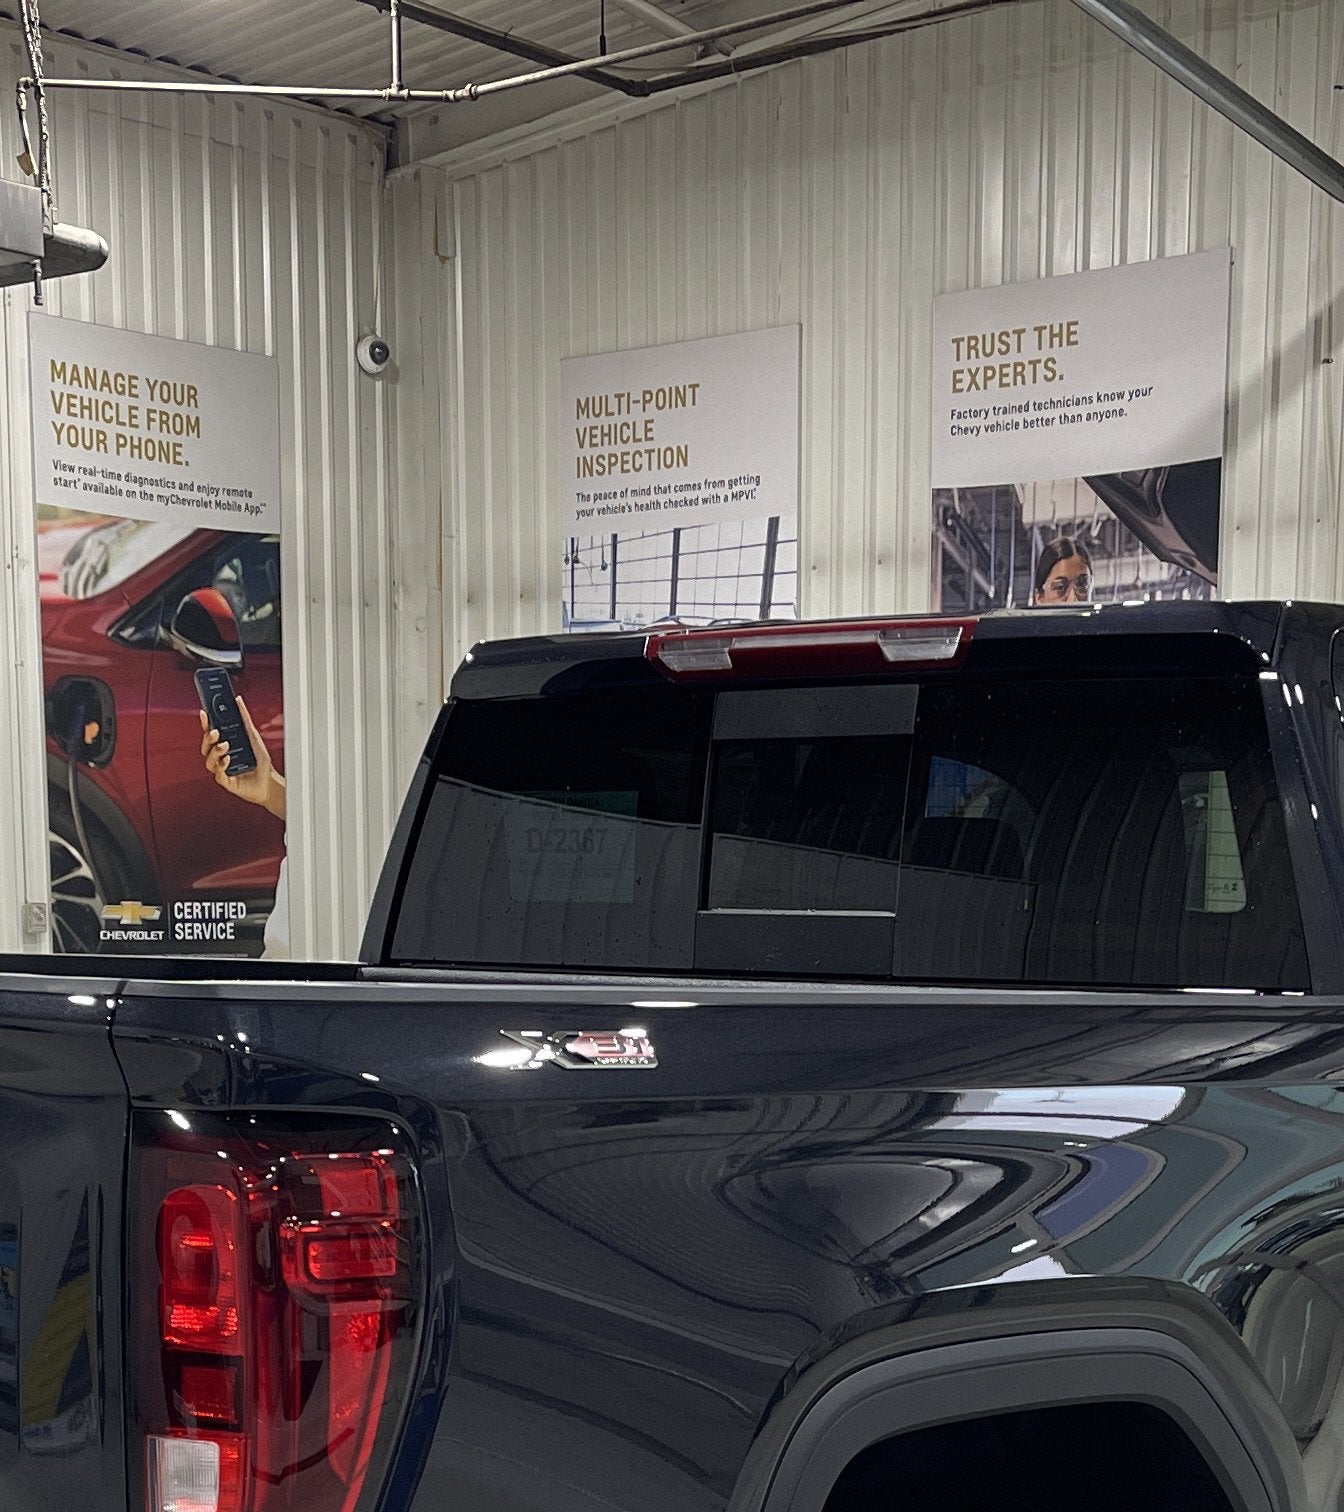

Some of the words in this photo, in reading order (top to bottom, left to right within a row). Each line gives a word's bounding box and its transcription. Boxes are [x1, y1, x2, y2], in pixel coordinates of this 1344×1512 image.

[951, 327, 1027, 362] TRUST
[1033, 320, 1079, 351] THE
[50, 358, 139, 399] MANAGE
[145, 377, 199, 409] YOUR
[952, 356, 1064, 394] EXPERTS.
[50, 389, 140, 429] VEHICLE
[146, 407, 201, 439] FROM
[576, 383, 700, 421] MULTI-POINT
[950, 407, 990, 421] Factory
[992, 400, 1030, 416] trained
[1032, 394, 1094, 412] technicians
[1096, 390, 1126, 404] know
[1127, 386, 1154, 403] your
[575, 418, 655, 449] VEHICLE
[950, 424, 982, 438] Chevy
[983, 418, 1020, 433] vehicle
[1022, 416, 1056, 430] better
[1058, 412, 1083, 425] than
[1085, 407, 1128, 423] anyone.
[51, 420, 109, 454] YOUR
[115, 432, 189, 467] PHONE.
[52, 458, 76, 474] View
[77, 465, 122, 482] real-time
[124, 471, 176, 490] diagnostics
[178, 480, 195, 492] and
[196, 482, 221, 496] enjoy
[222, 487, 253, 499] remote
[576, 444, 688, 479] INSPECTION
[82, 481, 123, 497] available
[125, 489, 137, 499] on
[139, 489, 155, 502] the
[156, 493, 213, 510] myChevrolet
[214, 495, 242, 513] Mobile
[575, 491, 591, 504] The
[593, 490, 618, 504] peace
[619, 487, 629, 499] of
[630, 484, 652, 498] mind
[653, 483, 672, 496] that
[673, 482, 702, 494] comes
[703, 478, 726, 491] from
[727, 474, 761, 490] getting
[575, 507, 595, 521] your
[596, 501, 633, 516] vehicle's
[634, 499, 662, 512] health
[663, 494, 700, 510] checked
[701, 492, 721, 506] with
[723, 494, 729, 503] a
[173, 901, 246, 920] CERTIFIED
[99, 929, 165, 941] CHEVROLET
[174, 921, 235, 940] SERVICE
